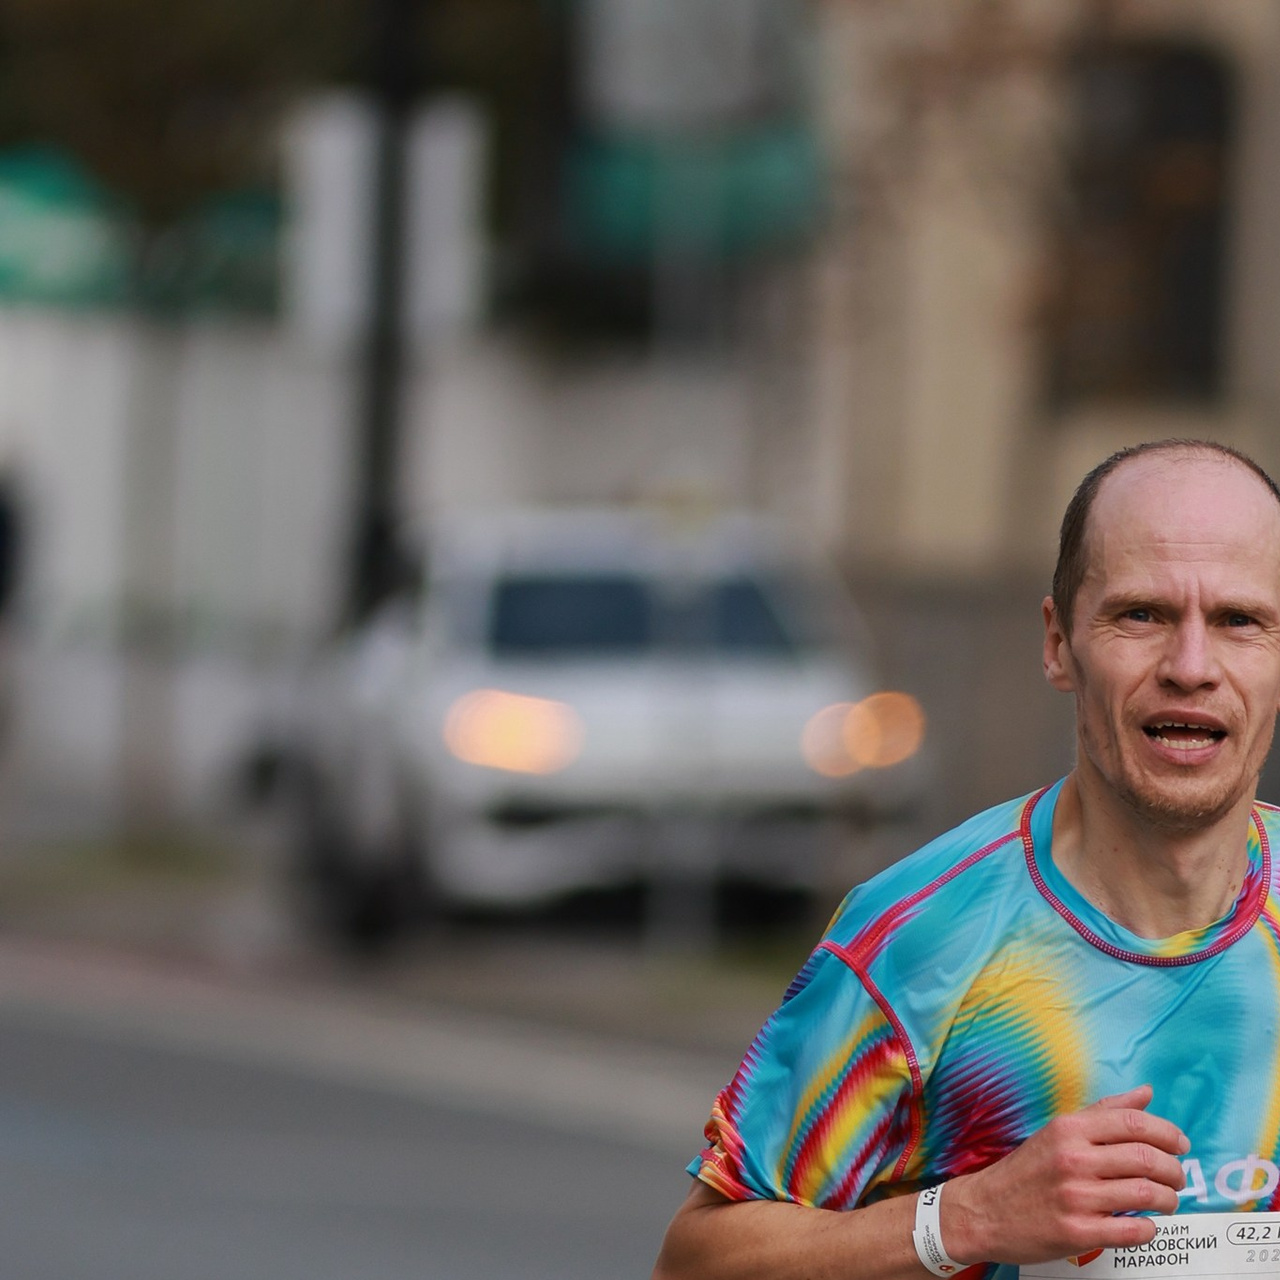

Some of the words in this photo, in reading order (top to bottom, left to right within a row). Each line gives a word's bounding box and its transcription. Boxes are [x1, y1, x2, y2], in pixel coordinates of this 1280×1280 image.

[922, 1185, 938, 1207] 42
[1155, 1224, 1189, 1236] РАЙМ
[1236, 1226, 1271, 1241] 42,2
[1114, 1252, 1189, 1269] МАРАФОН
